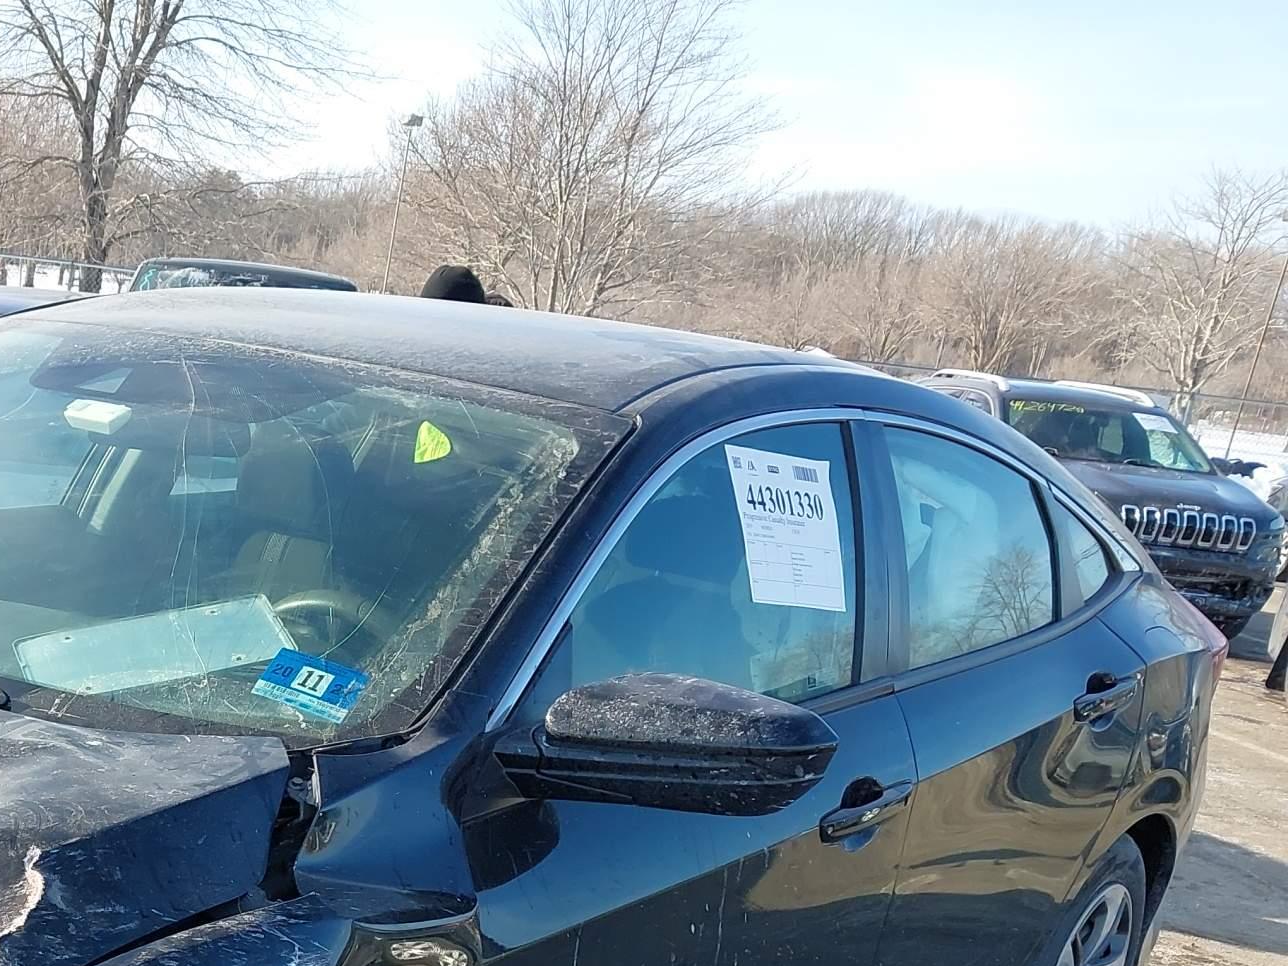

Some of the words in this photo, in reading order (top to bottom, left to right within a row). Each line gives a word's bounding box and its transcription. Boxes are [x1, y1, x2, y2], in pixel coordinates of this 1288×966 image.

[746, 483, 824, 521] 44301330
[271, 663, 294, 678] 20
[296, 669, 325, 692] 11
